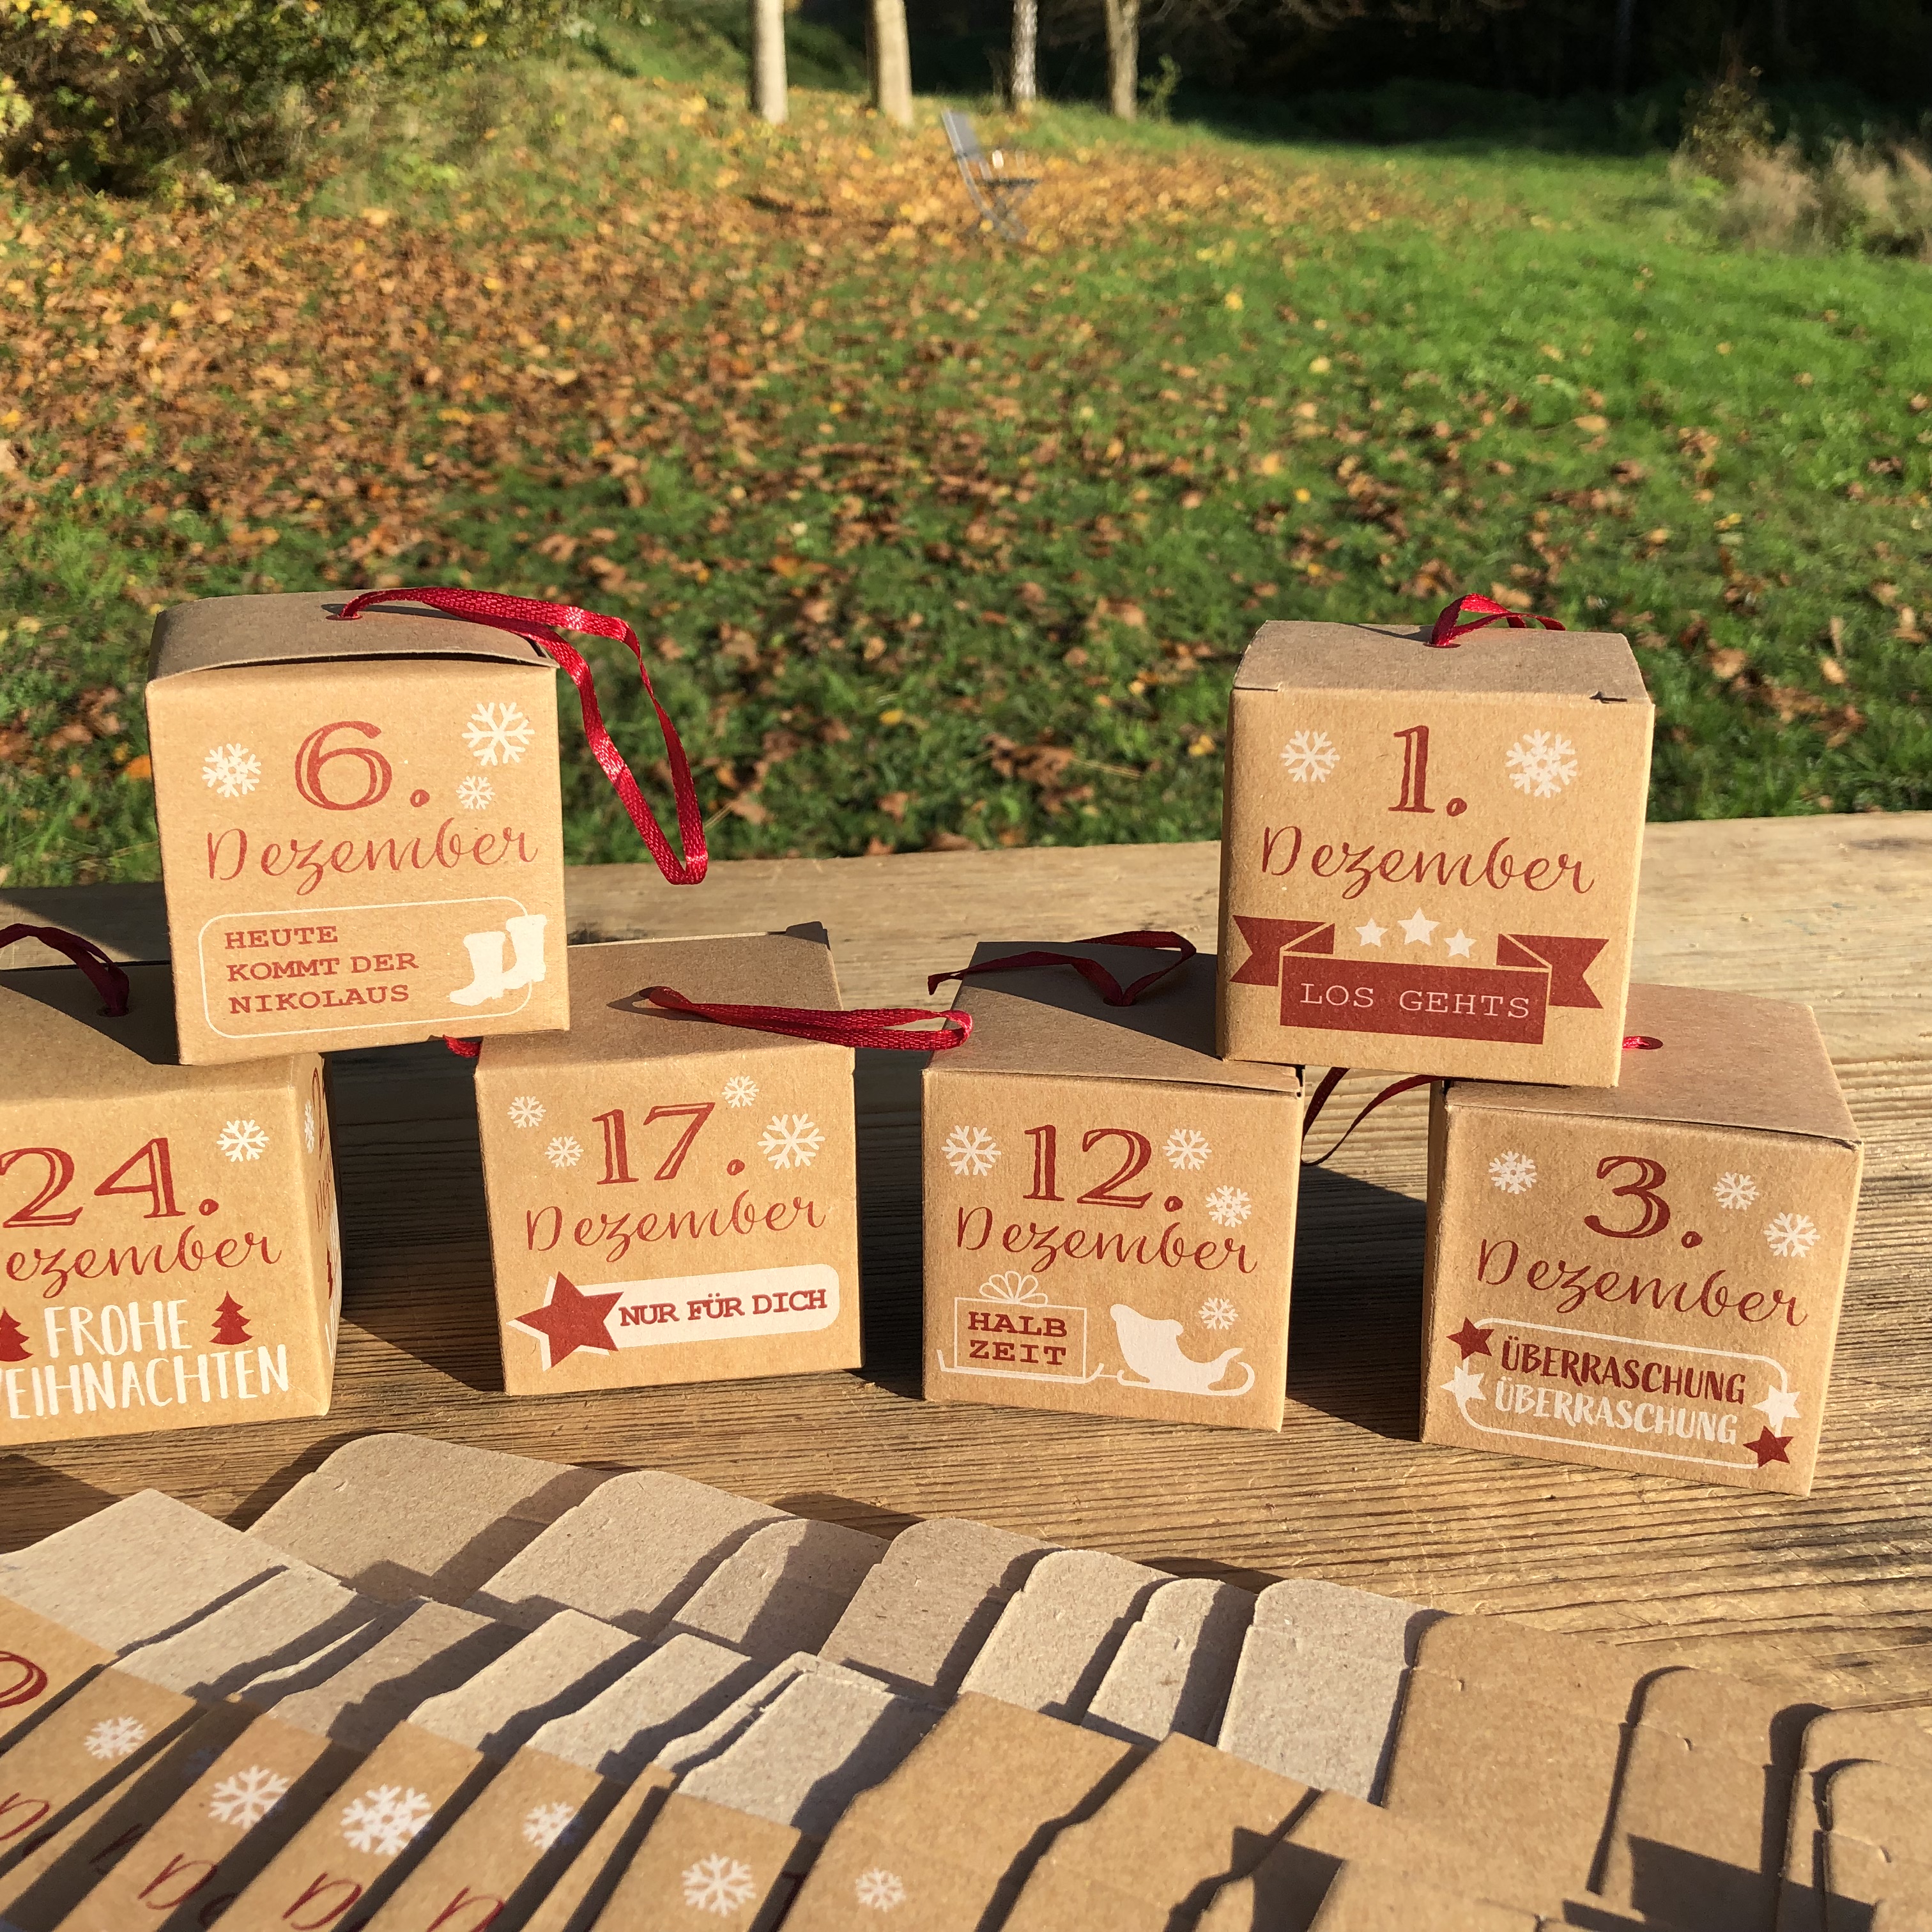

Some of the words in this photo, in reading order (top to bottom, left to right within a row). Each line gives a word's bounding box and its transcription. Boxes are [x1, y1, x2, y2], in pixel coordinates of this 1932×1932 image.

[294, 721, 430, 811] 6.
[1388, 725, 1468, 816] 1.
[207, 817, 538, 895] Dezember
[1262, 825, 1595, 899] Dezember
[225, 926, 338, 949] HEUTE
[226, 958, 340, 982] KOMMT
[351, 953, 419, 974] DER
[229, 985, 410, 1015] NIKOLAUS
[1300, 983, 1374, 1008] LOS
[1399, 990, 1530, 1019] GEHTS
[592, 1102, 745, 1185] 17.
[1022, 1124, 1184, 1213] 12.
[0, 1137, 219, 1228] 24.
[1584, 1156, 1703, 1249] 3.
[6, 1225, 282, 1299] ezember
[526, 1190, 826, 1262] Dezember
[957, 1206, 1257, 1274] Dezember
[618, 1303, 680, 1327] NUR
[687, 1292, 746, 1321] FÜR
[752, 1288, 828, 1315] DICH
[1478, 1238, 1808, 1327] Dezember
[44, 1300, 192, 1359] FROHE
[968, 1311, 1068, 1337] HALB
[969, 1340, 1067, 1366] ZEIT
[0, 1344, 289, 1420] EIHNACHTEN
[1501, 1335, 1746, 1405] ÜBERRASCHUNG
[1494, 1376, 1738, 1445] ÜBERRASCHUNG
